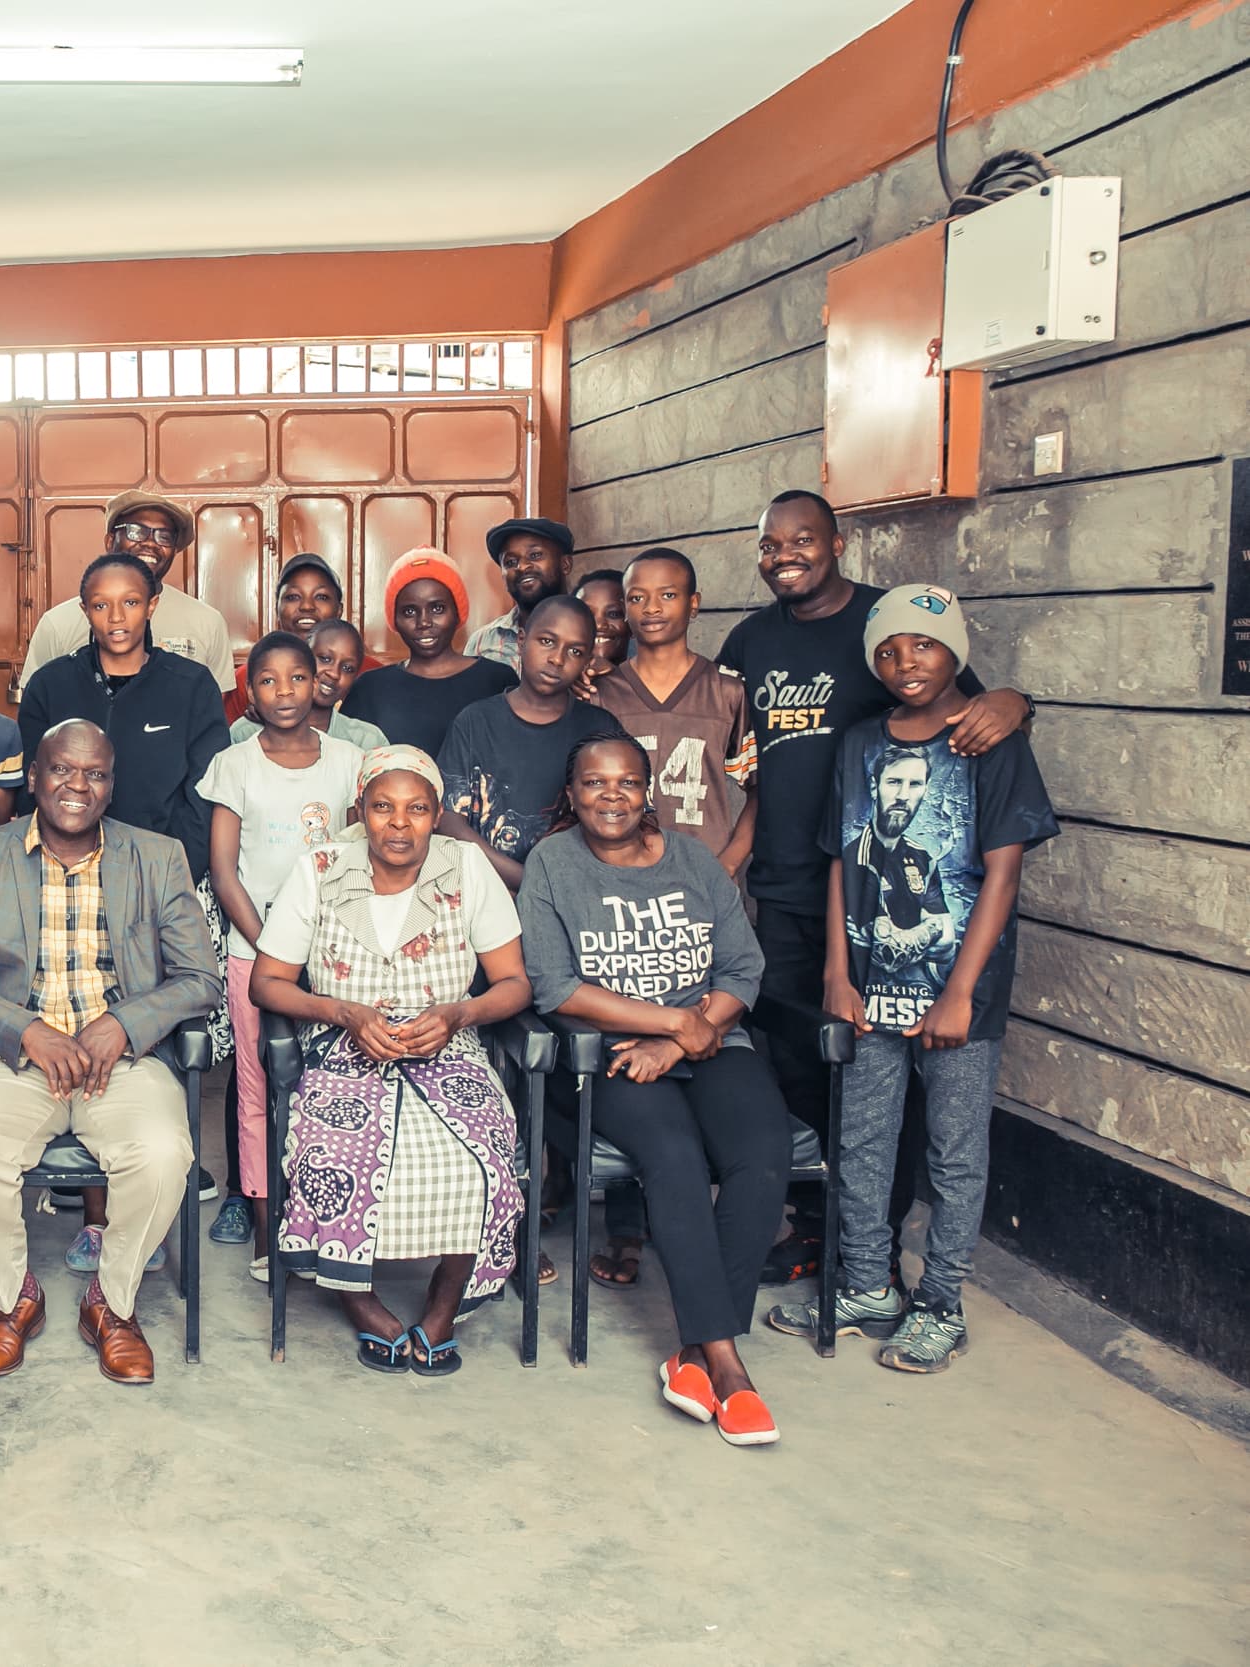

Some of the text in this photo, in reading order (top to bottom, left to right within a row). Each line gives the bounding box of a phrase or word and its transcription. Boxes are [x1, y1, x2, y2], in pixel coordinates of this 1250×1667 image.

[754, 670, 835, 711] Sauti
[767, 708, 826, 730] FEST
[602, 891, 689, 931] THE
[579, 922, 714, 953] DUPLICATE
[599, 975, 672, 998] MAED
[865, 983, 888, 994] THE
